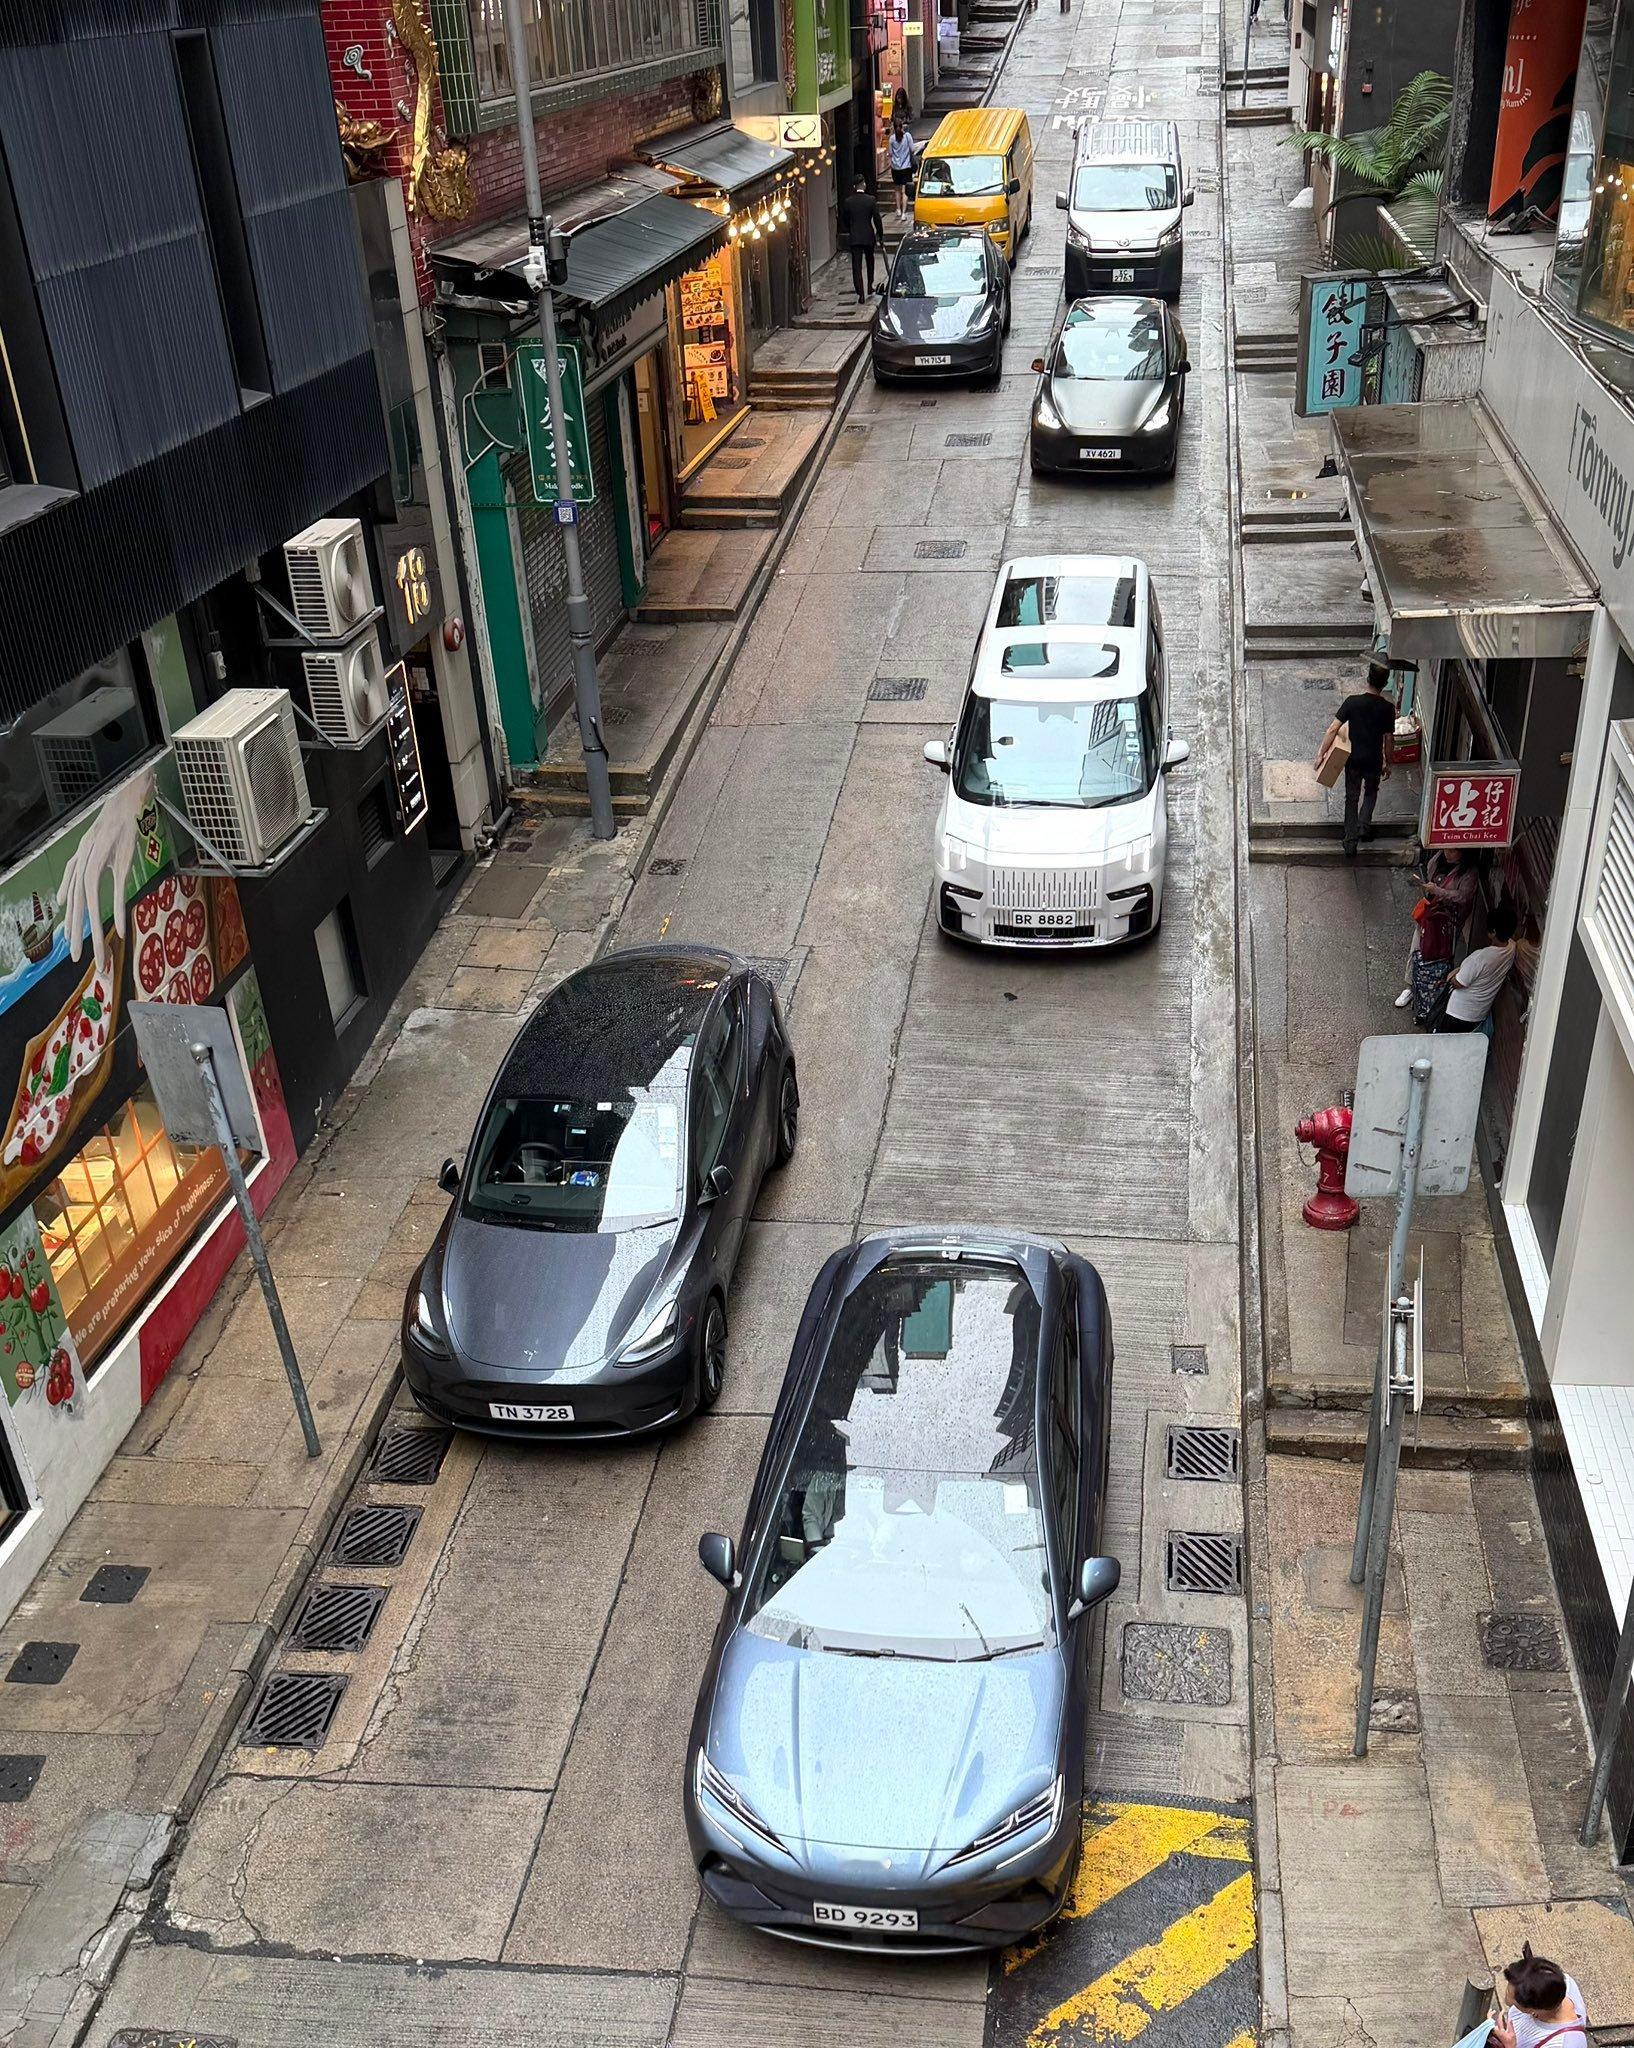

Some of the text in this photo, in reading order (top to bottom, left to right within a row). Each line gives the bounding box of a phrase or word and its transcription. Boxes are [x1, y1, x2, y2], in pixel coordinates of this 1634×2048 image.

[1322, 293, 1354, 401] 餃子園
[1098, 450, 1116, 458] 4621
[1442, 831, 1498, 840] Tsim Chai Kee
[1015, 914, 1074, 925] BR 8882
[87, 1311, 102, 1333] are
[102, 1265, 139, 1320] preparing
[138, 1246, 156, 1270] your
[155, 1225, 173, 1246] slice
[173, 1209, 182, 1228] of
[494, 1405, 569, 1419] TN 3728
[815, 1907, 916, 1927] BD 9293
